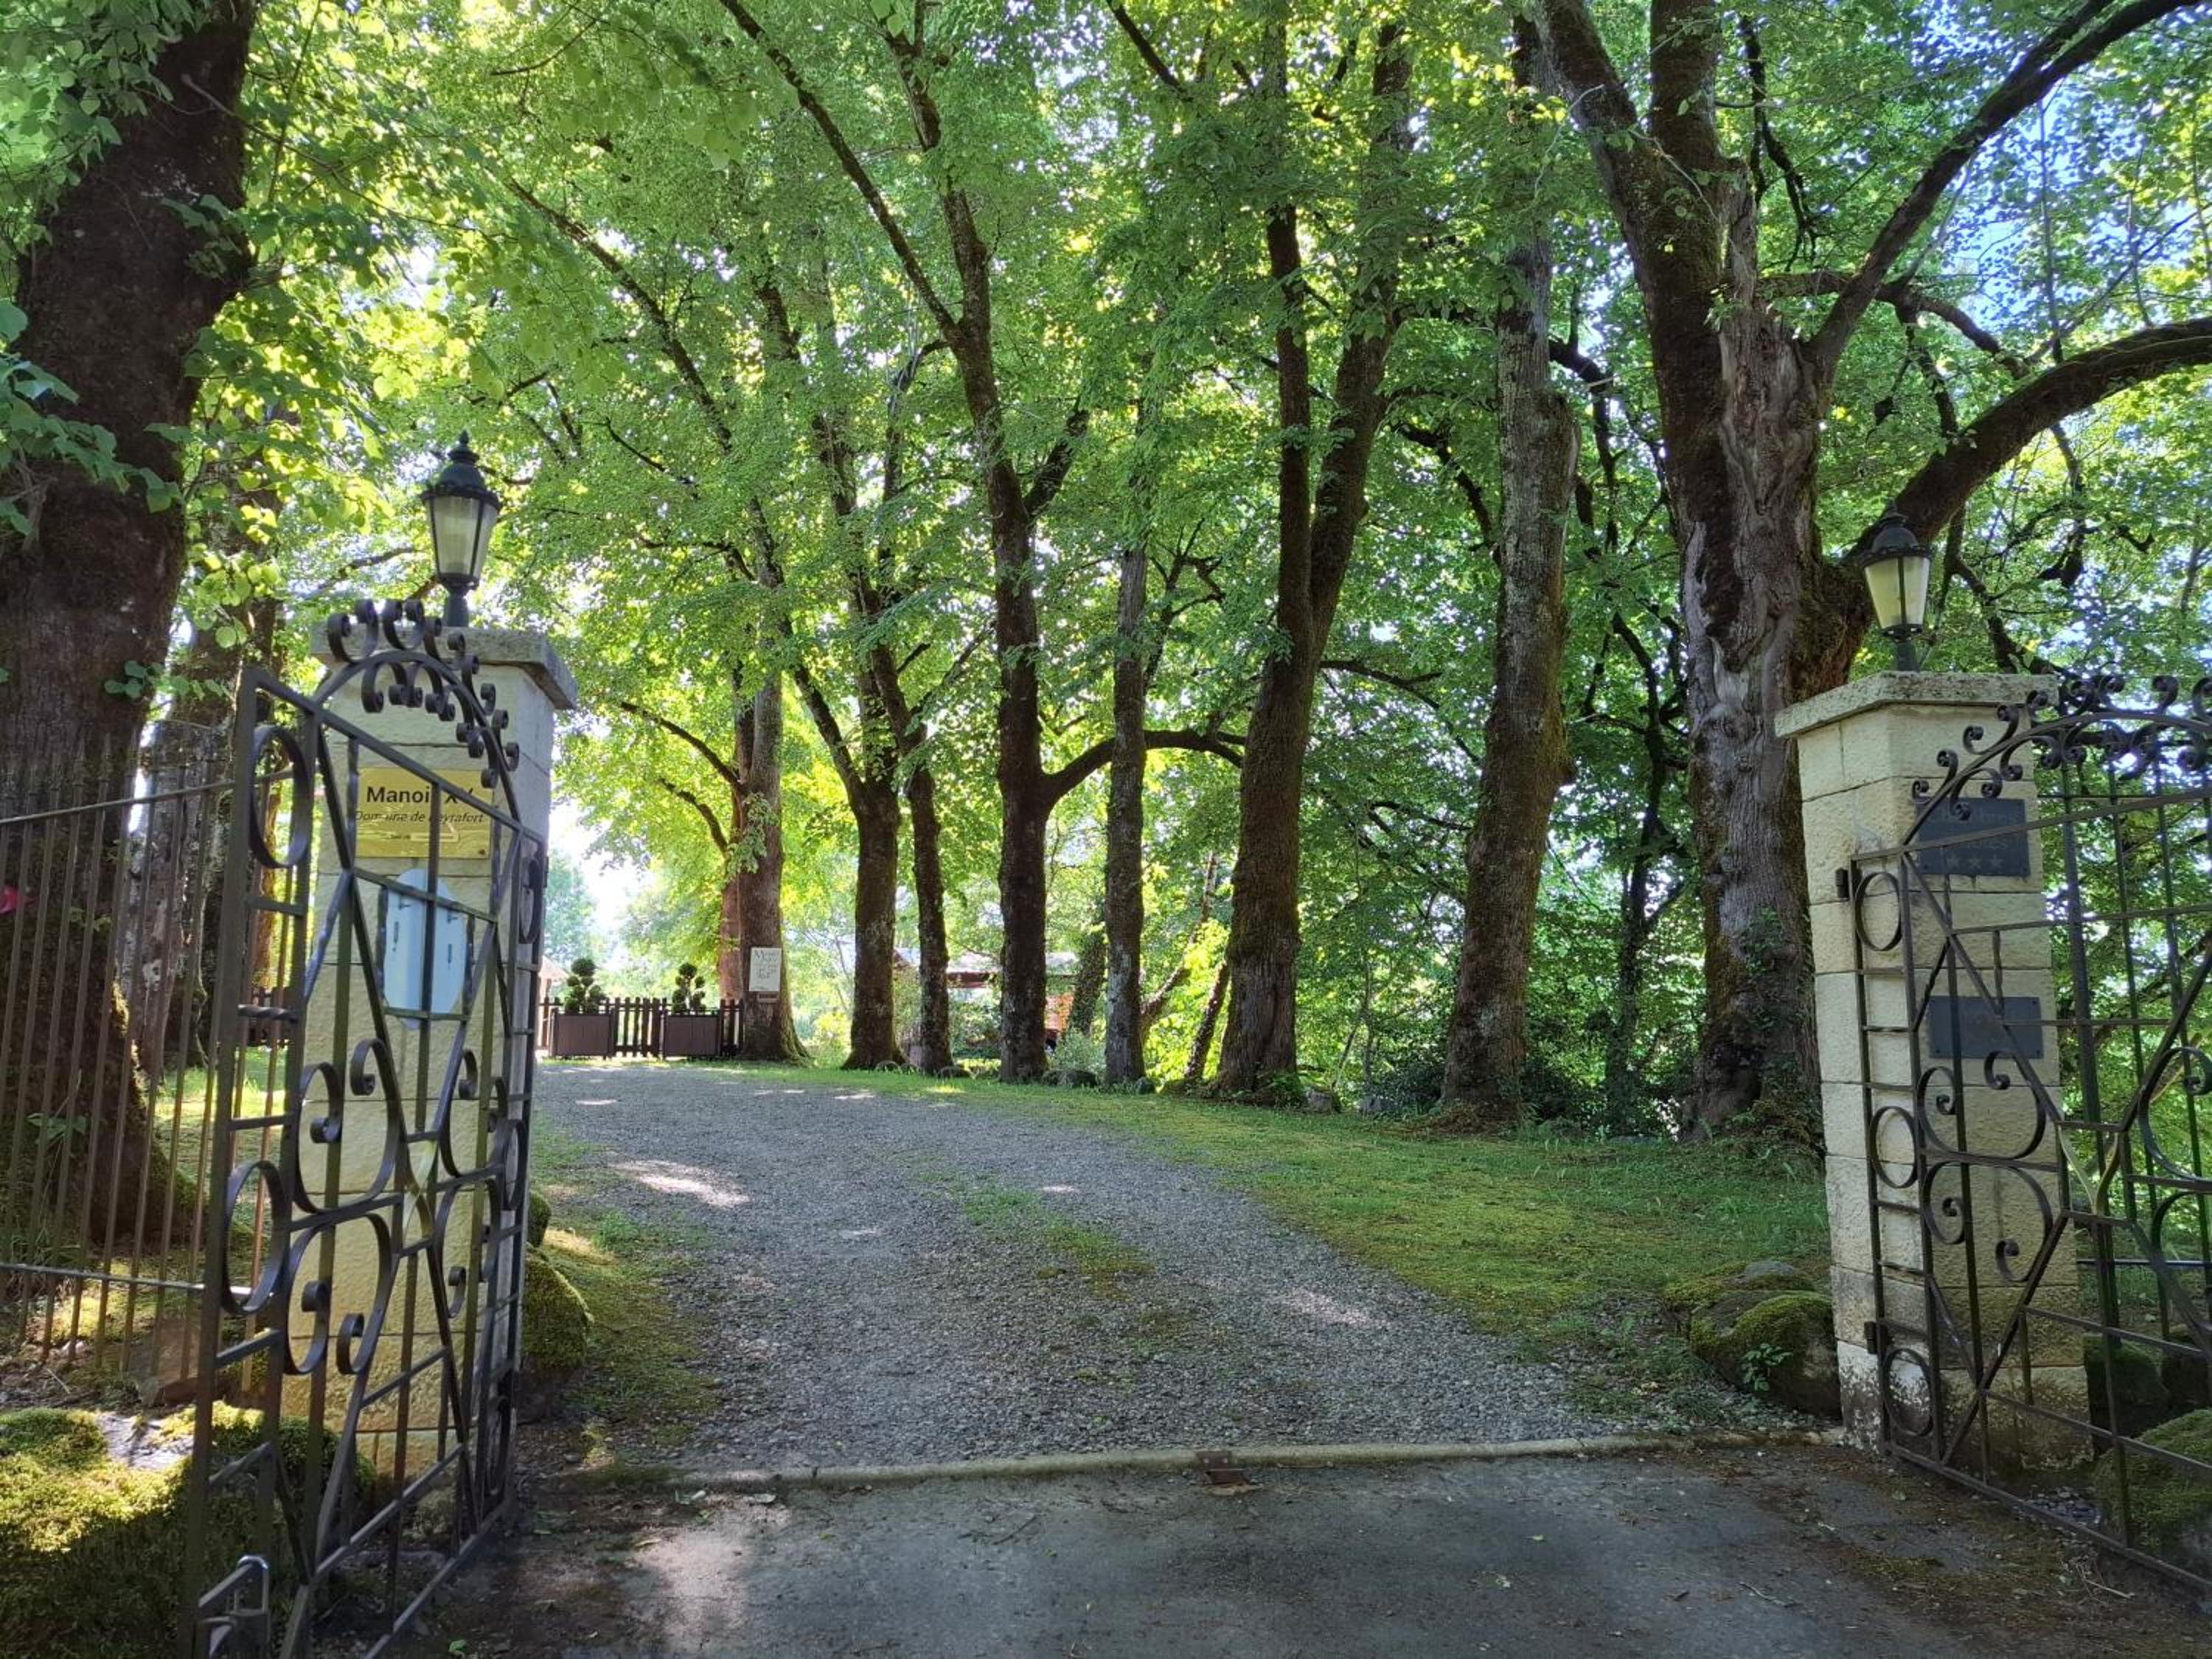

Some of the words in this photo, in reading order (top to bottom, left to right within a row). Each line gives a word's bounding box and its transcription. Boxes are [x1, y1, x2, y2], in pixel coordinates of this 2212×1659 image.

[366, 785, 435, 804] Manoi
[410, 810, 425, 822] de
[429, 812, 484, 825] eyrafort
